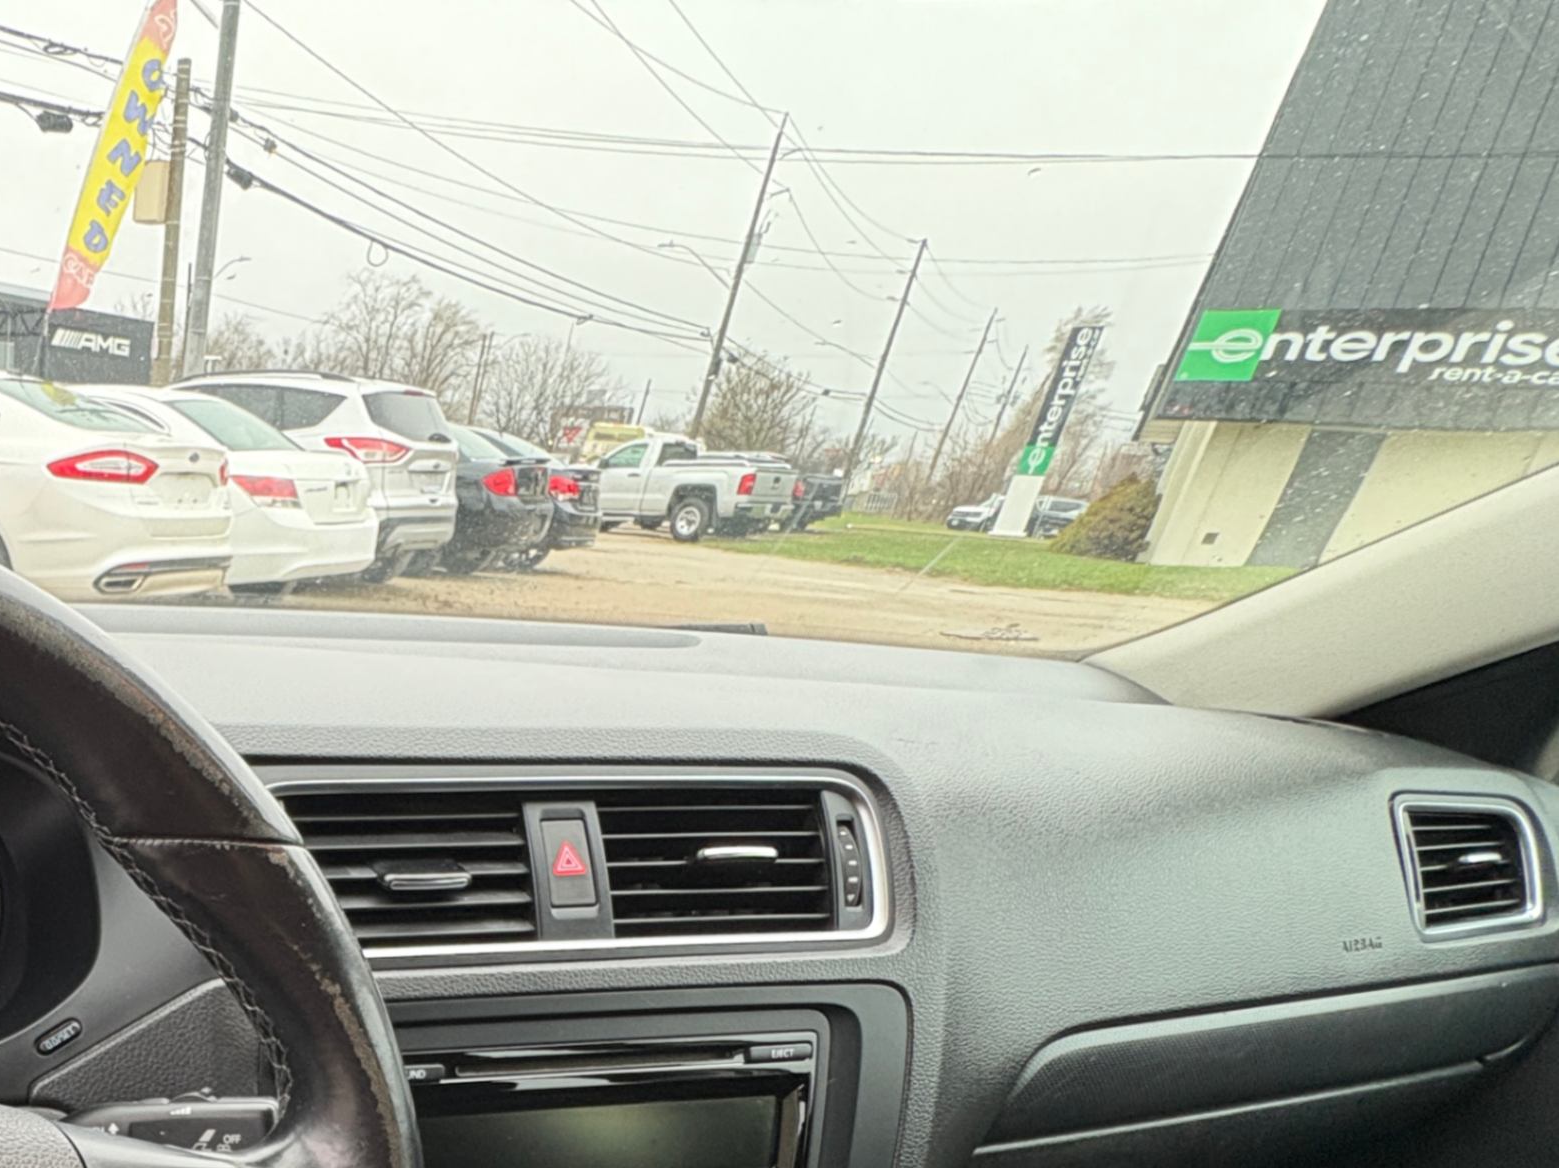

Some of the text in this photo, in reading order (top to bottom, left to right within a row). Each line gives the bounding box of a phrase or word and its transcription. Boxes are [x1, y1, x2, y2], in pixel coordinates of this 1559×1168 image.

[78, 334, 131, 358] AMG
[1428, 364, 1559, 385] rent-a-ca
[1027, 327, 1094, 474] enterprise
[771, 1048, 795, 1058] EJECT
[407, 1068, 427, 1080] ND
[222, 1133, 242, 1145] OFF
